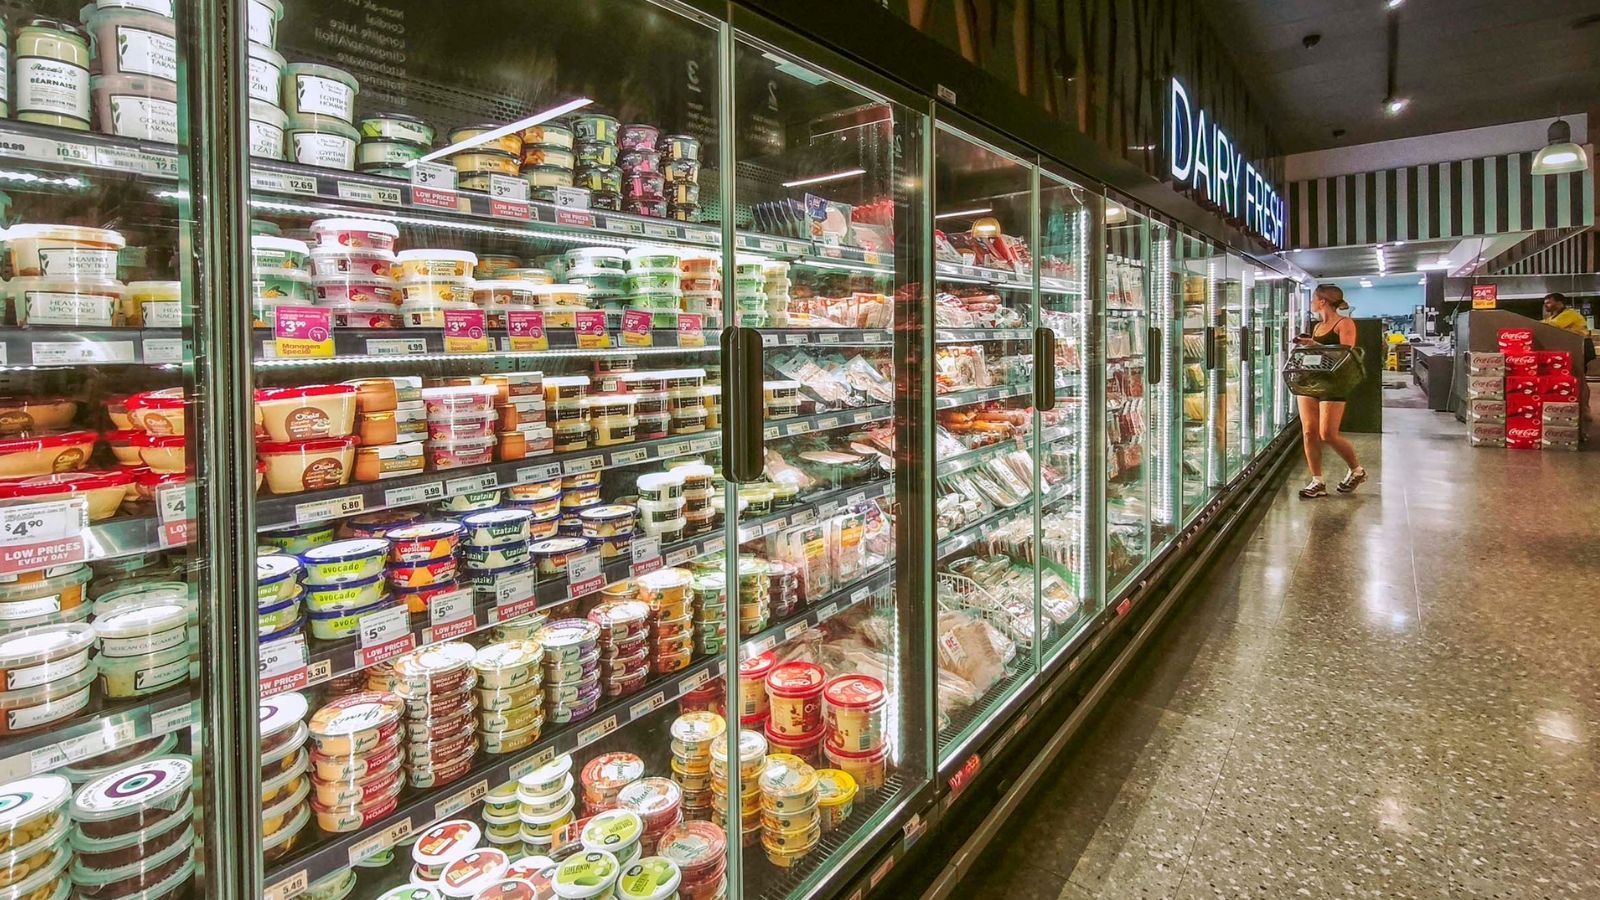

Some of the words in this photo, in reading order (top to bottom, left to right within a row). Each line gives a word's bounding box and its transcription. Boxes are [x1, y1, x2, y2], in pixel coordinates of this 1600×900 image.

[140, 117, 177, 128] GOURME
[156, 161, 178, 171] 12.6
[1171, 77, 1242, 218] DAIRY
[1245, 162, 1284, 250] FRESH
[290, 180, 313, 190] 12.69
[377, 192, 398, 201] 12.69
[415, 191, 430, 199] LOW
[431, 193, 455, 203] PRICES
[507, 205, 527, 213] PRICES
[1500, 331, 1530, 340] Coca-Cola
[407, 343, 424, 352] 4.99
[1508, 427, 1540, 437] Coca-Cola
[424, 486, 440, 496] 9.99
[341, 501, 360, 511] 6.80
[492, 526, 520, 536] tzatziki
[5, 549, 34, 561] LOW
[37, 541, 81, 556] PRICES
[18, 555, 49, 566] EVERY
[50, 552, 69, 561] DAY
[322, 563, 360, 574] avocado
[319, 590, 356, 603] avocado
[500, 607, 512, 616] LOW
[512, 600, 534, 613] PRICES
[333, 618, 355, 629] avoc
[434, 626, 449, 635] LOW
[449, 619, 473, 631] PRICES
[366, 648, 382, 659] LOW
[384, 639, 409, 655] PRICES
[374, 653, 389, 662] EVERY
[389, 648, 404, 658] DAY
[307, 667, 327, 678] 5.30
[274, 672, 305, 687] PRICES
[391, 824, 409, 839] 5.49
